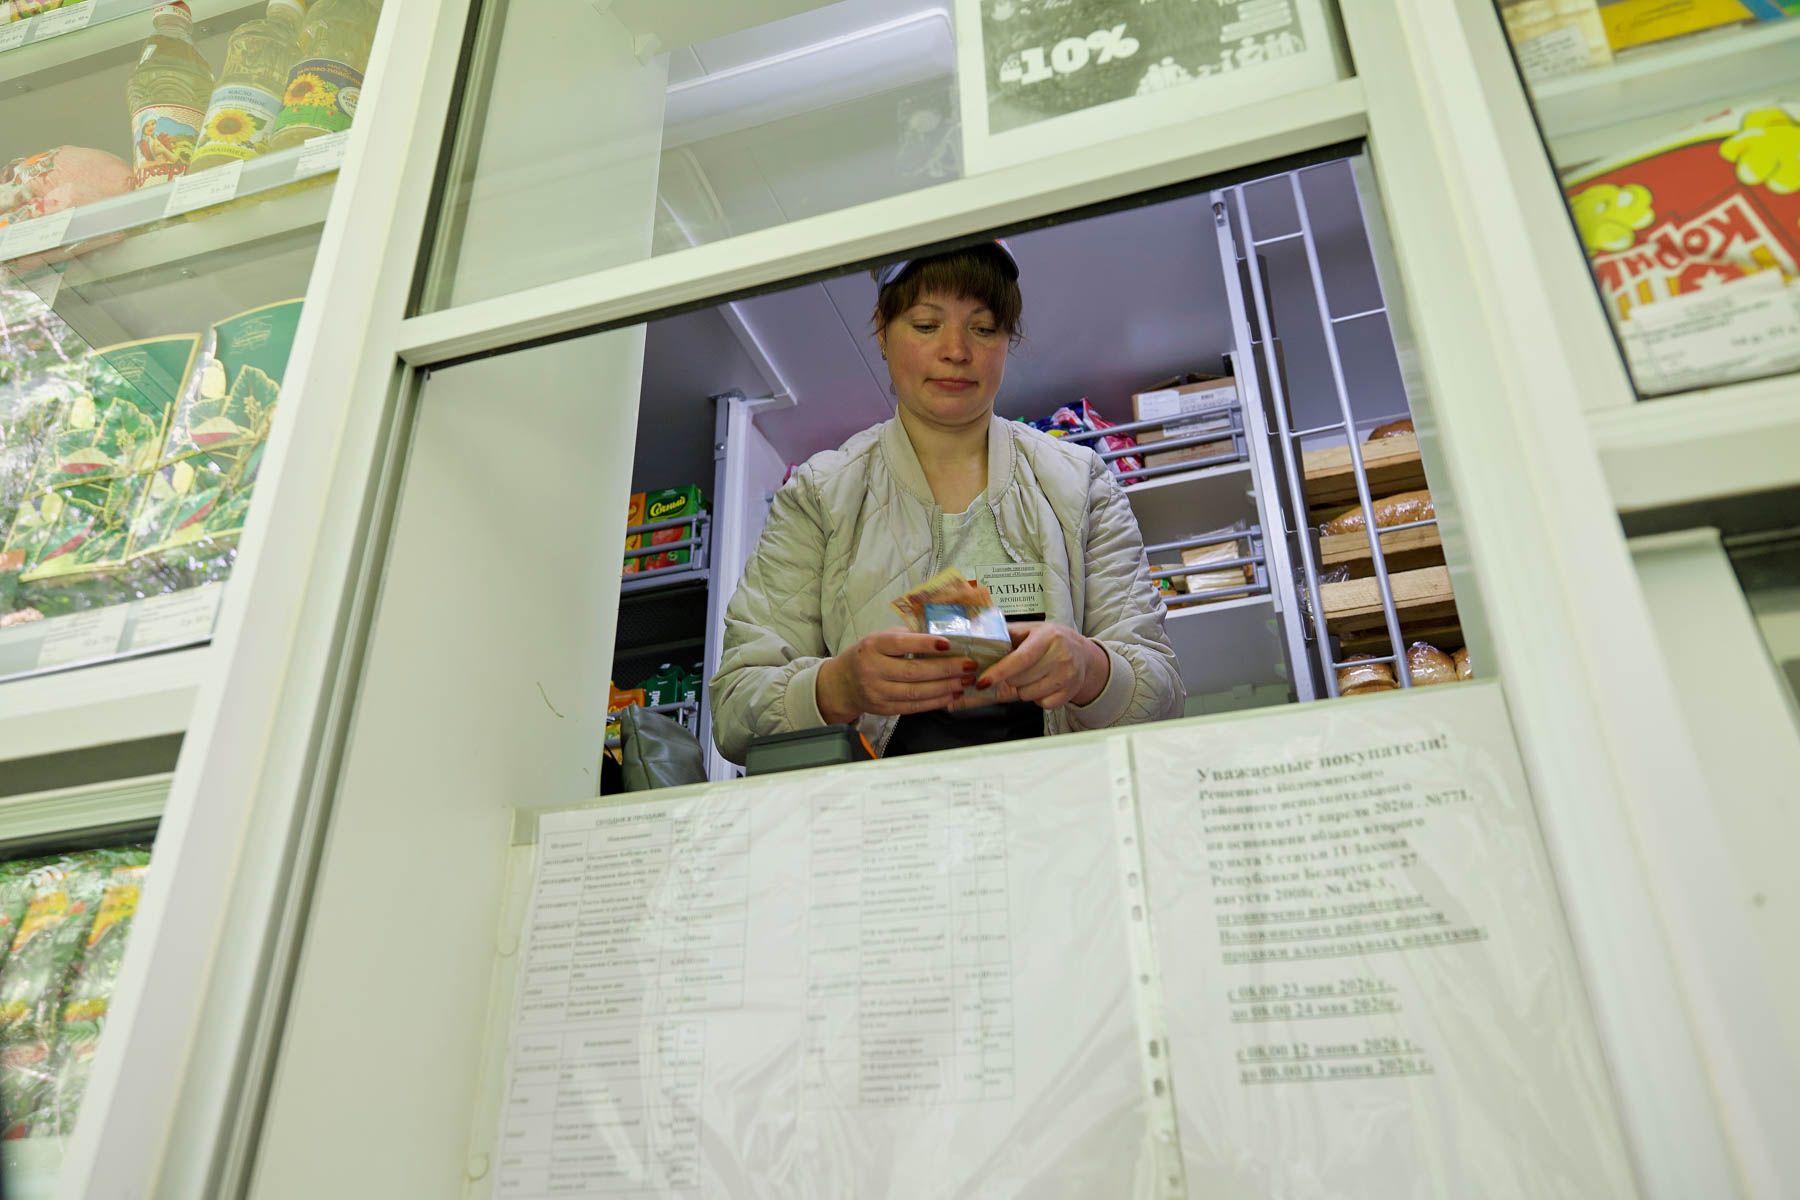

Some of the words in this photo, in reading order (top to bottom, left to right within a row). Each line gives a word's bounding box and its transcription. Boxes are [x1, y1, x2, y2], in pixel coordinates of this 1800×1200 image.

[987, 583, 1044, 595] ТАТЬЯНА
[1197, 759, 1313, 784] Уважаемые
[1319, 734, 1448, 770] покупатели!
[1203, 819, 1273, 834] комитета
[1276, 816, 1292, 829] от
[1296, 812, 1314, 827] 17
[1316, 807, 1371, 828] апреля
[1276, 846, 1330, 866] статьи
[1210, 869, 1301, 890] Республики
[1399, 852, 1419, 870] 27
